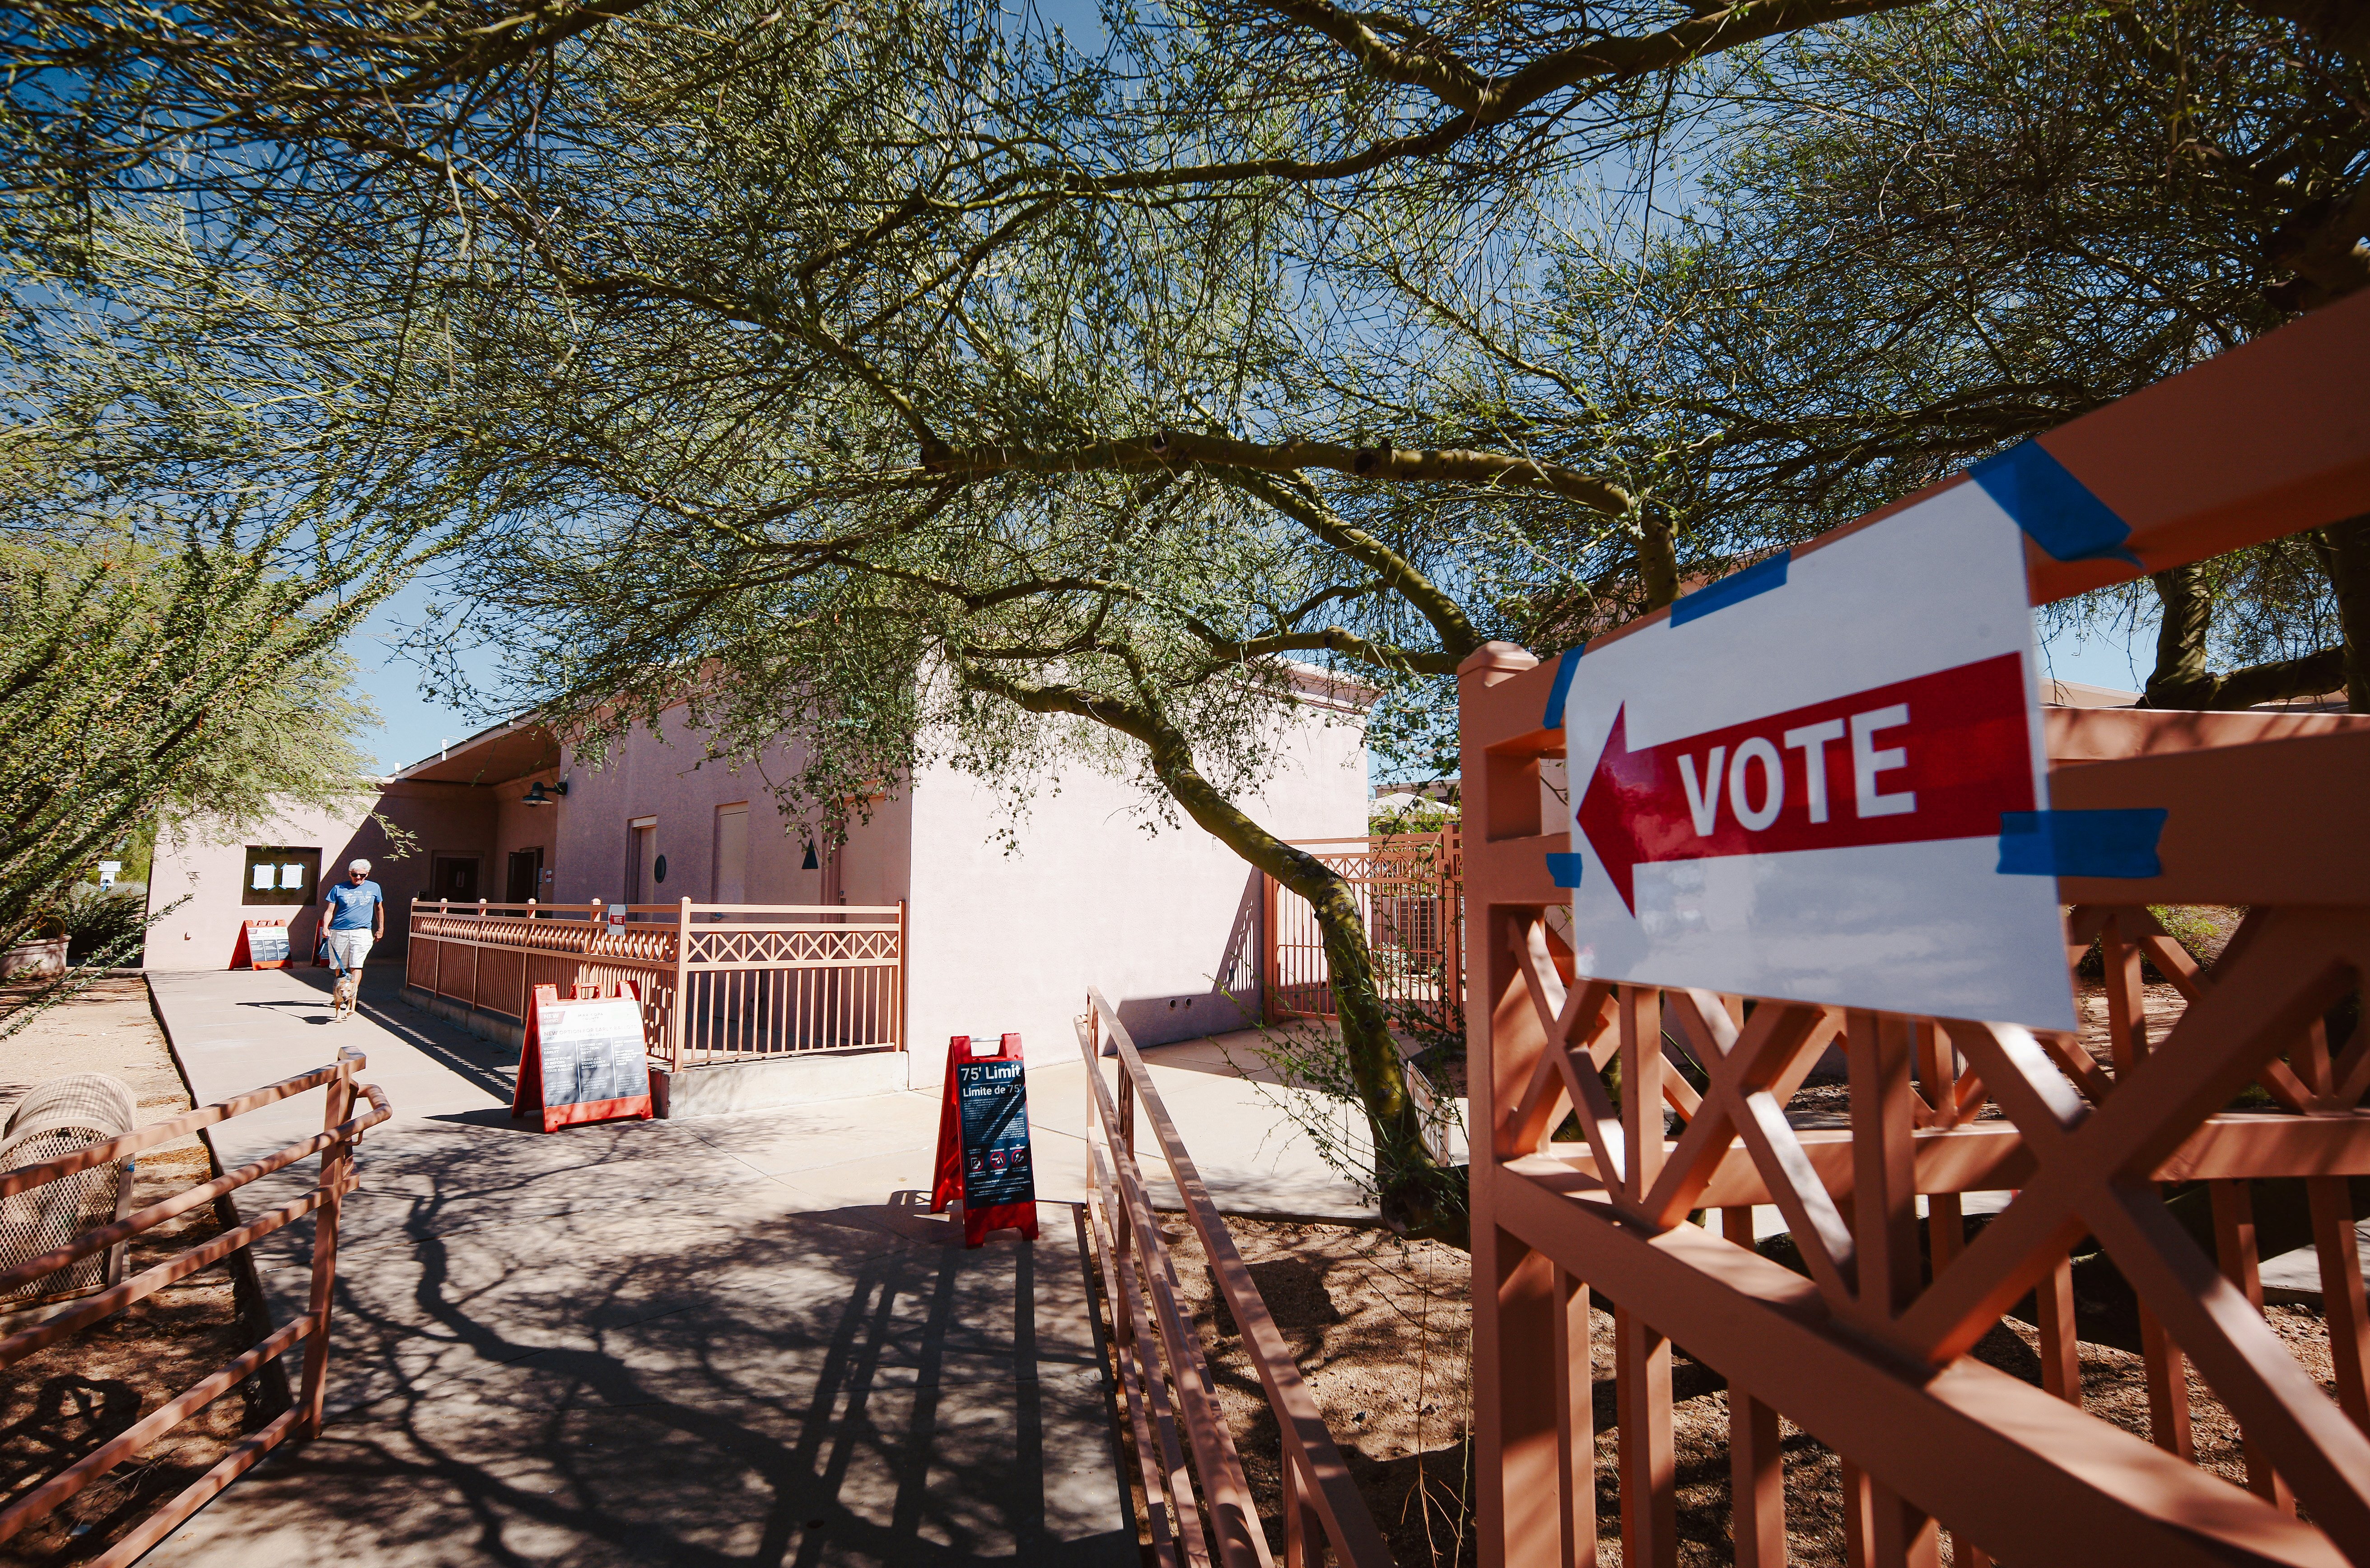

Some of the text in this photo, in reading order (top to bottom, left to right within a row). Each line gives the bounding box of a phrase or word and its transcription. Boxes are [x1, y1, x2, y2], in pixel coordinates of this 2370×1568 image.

[1677, 703, 1917, 837] VOTE
[961, 1064, 1021, 1081] 75' Limit
[963, 1084, 1022, 1097] Limite de 75'
